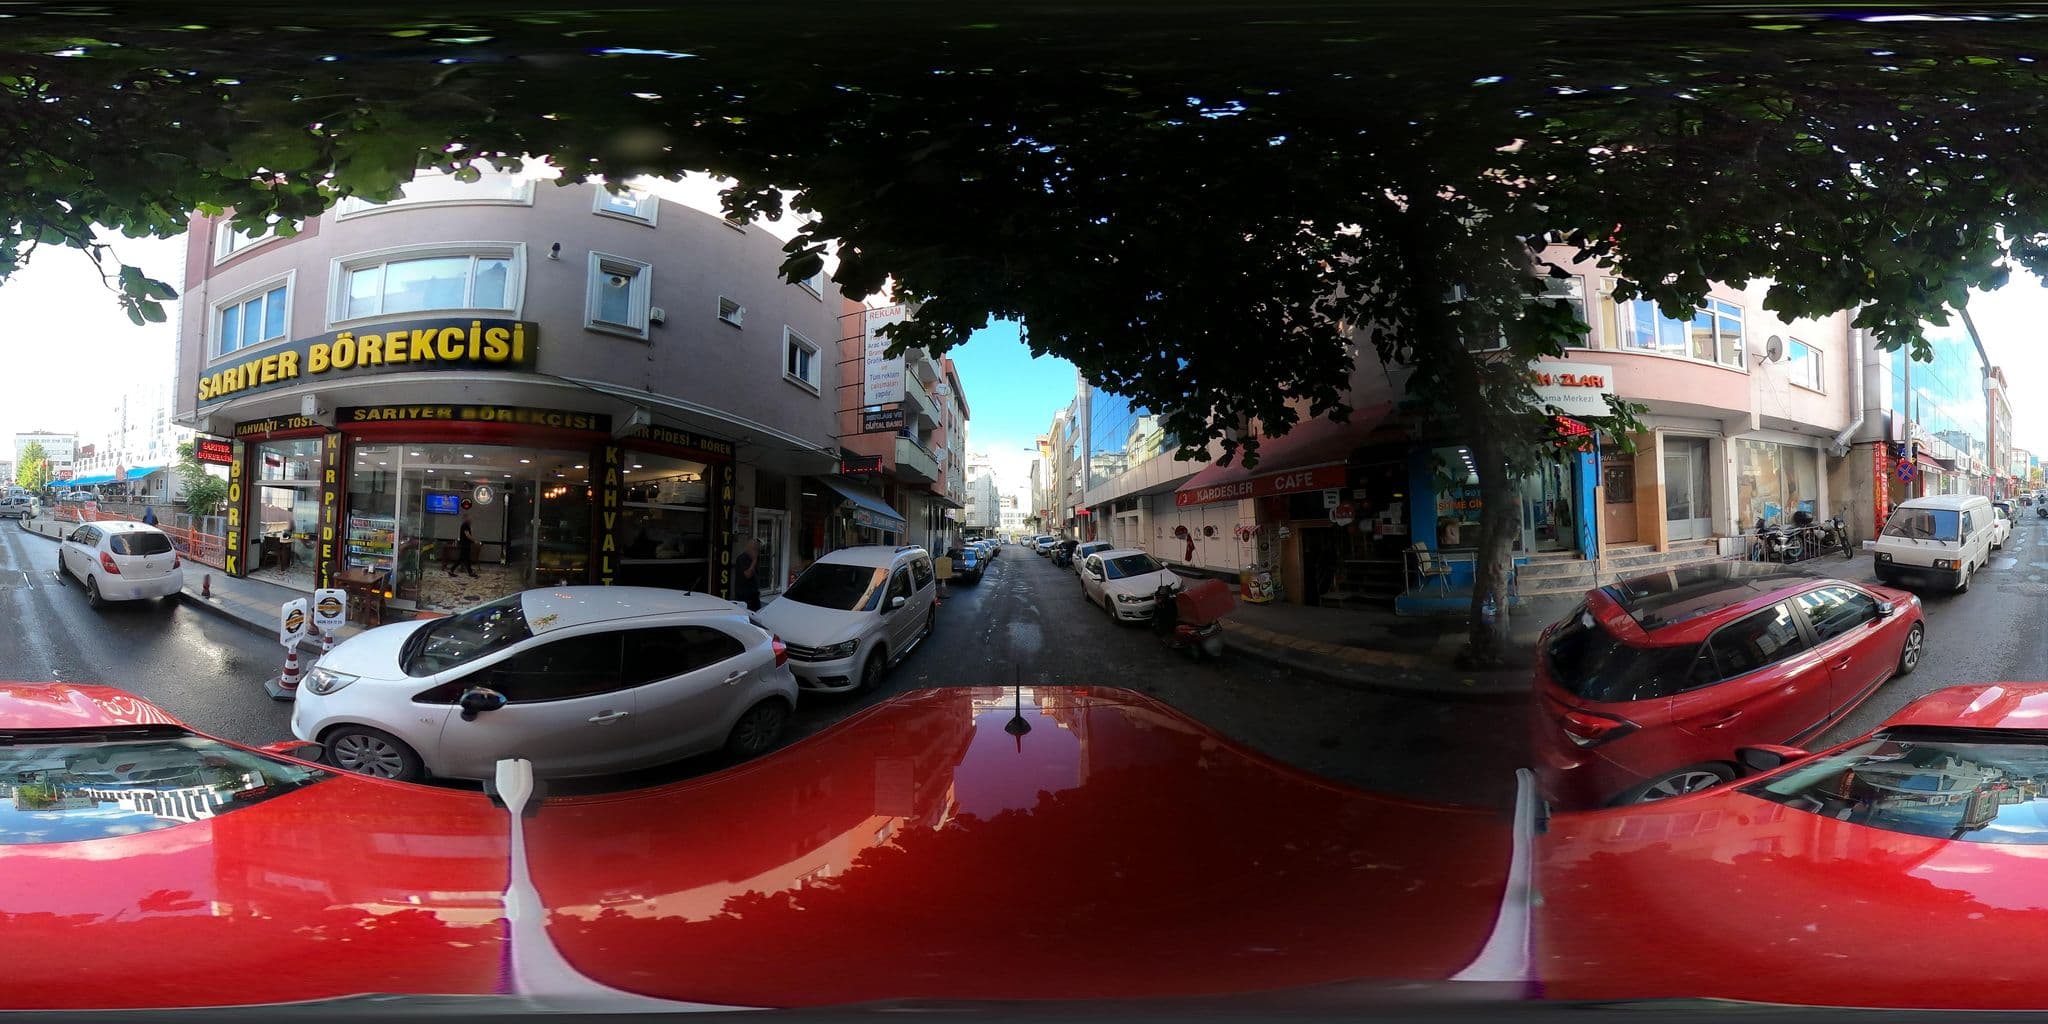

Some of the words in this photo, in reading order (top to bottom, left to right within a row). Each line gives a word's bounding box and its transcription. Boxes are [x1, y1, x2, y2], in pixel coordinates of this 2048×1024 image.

[869, 307, 902, 320] REKLAM
[199, 350, 299, 401] SARIYER
[308, 320, 525, 374] BÖREKCİSİ
[1537, 373, 1605, 388] HAZLARI
[1563, 394, 1595, 403] Merkezi
[353, 407, 454, 421] SARIYER
[325, 434, 337, 484] KIR
[1274, 472, 1314, 490] CAFE
[225, 459, 241, 576] BÖREK
[602, 447, 617, 587] KAHVALT
